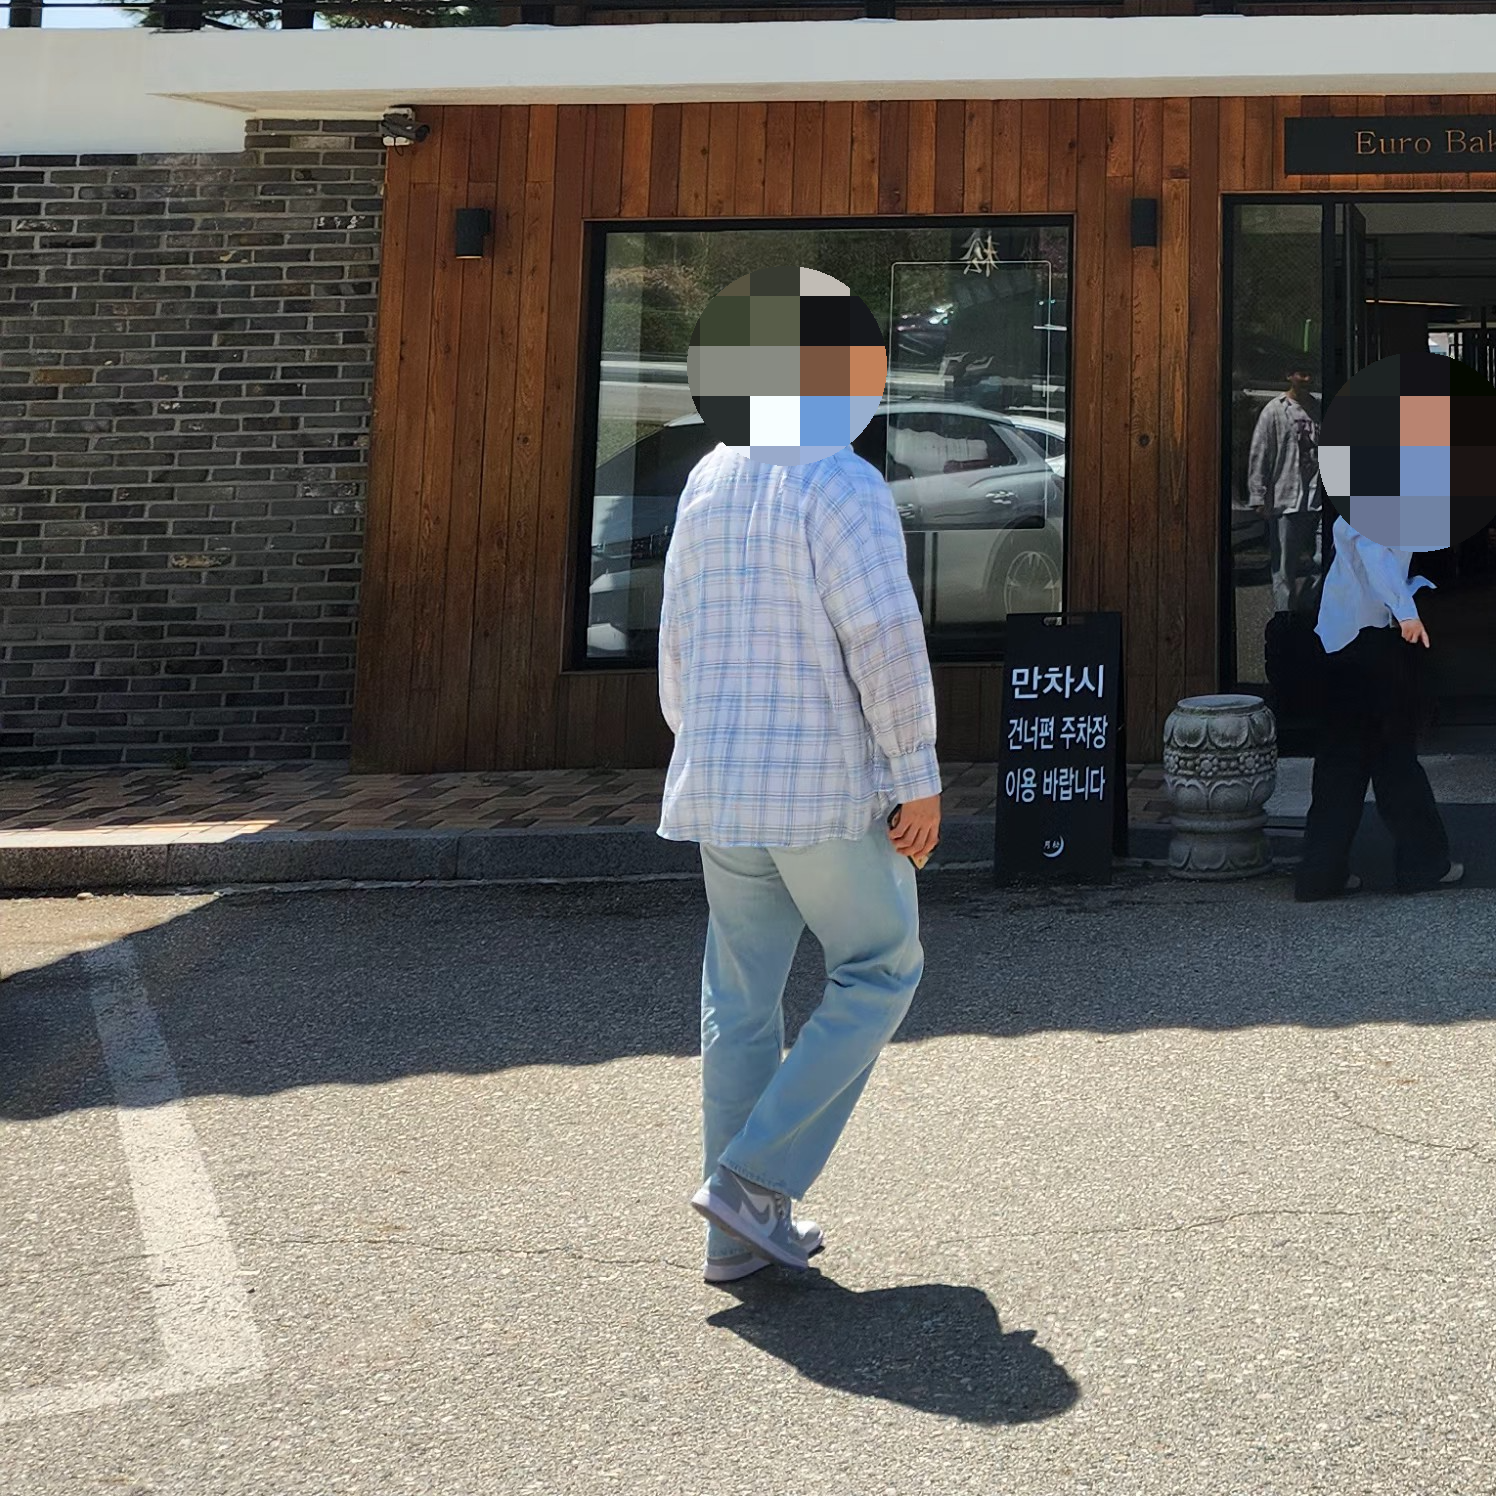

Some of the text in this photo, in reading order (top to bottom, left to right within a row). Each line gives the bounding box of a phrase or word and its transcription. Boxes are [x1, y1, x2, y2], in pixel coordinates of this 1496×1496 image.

[1354, 129, 1432, 156] Euro
[1011, 664, 1105, 700] 만차시
[1007, 714, 1108, 750] 건너편 주차장
[1005, 765, 1106, 803] 이용 바랍니다
